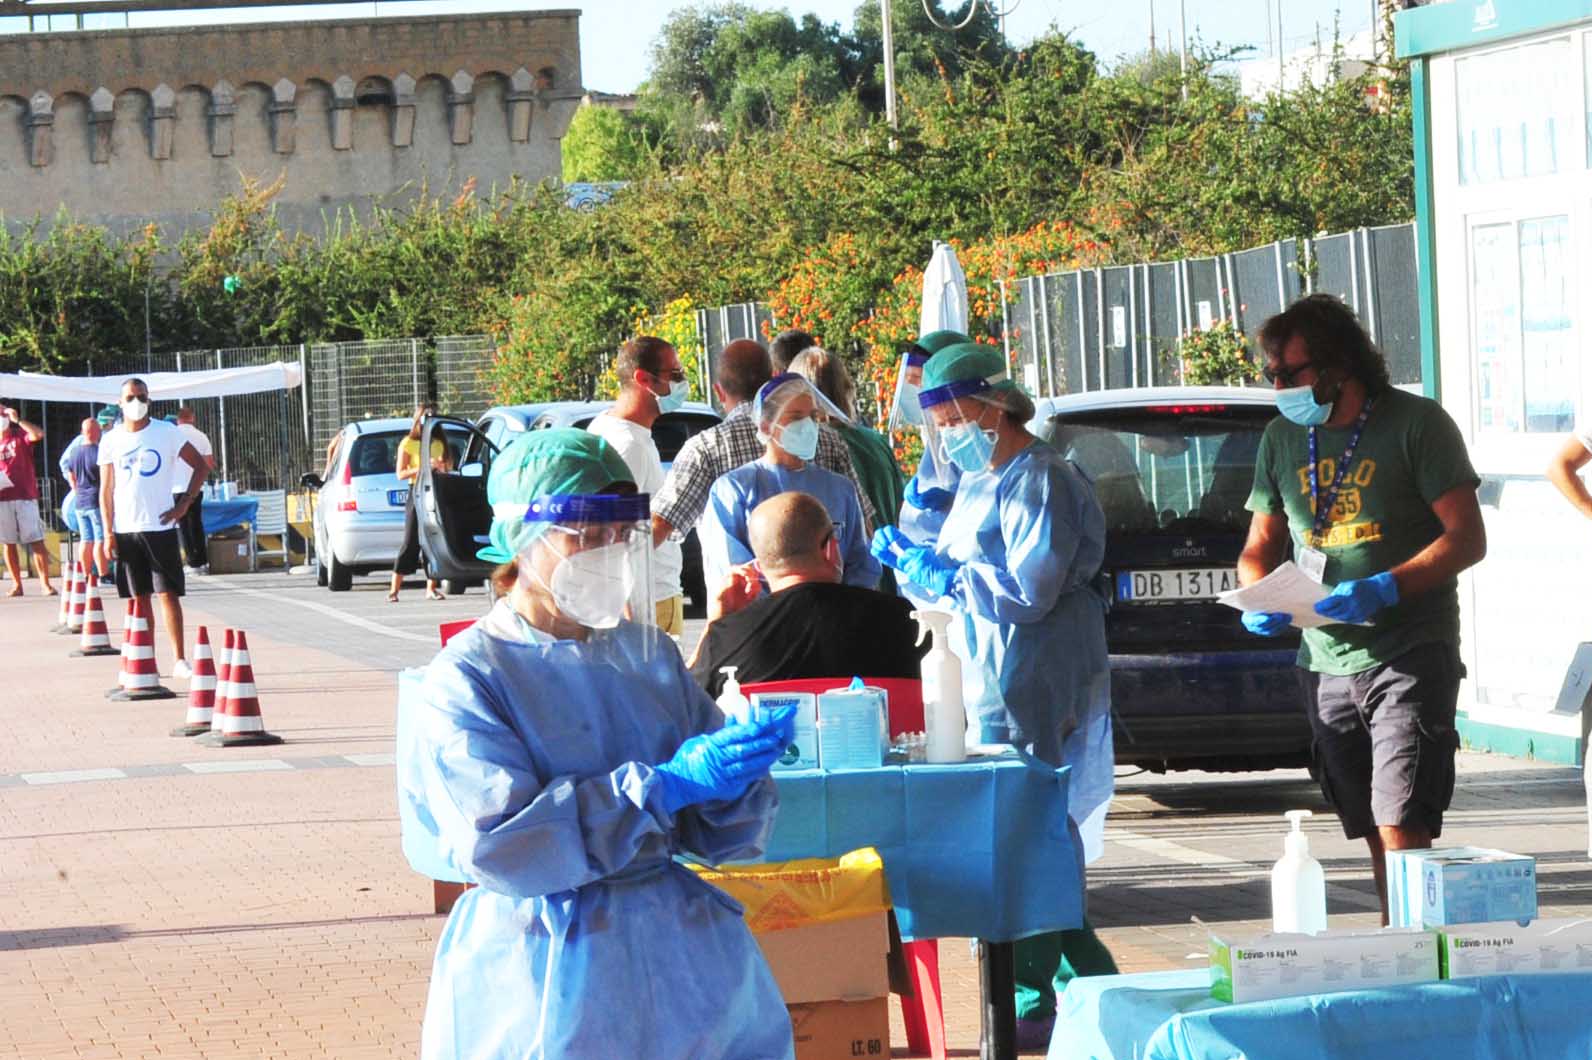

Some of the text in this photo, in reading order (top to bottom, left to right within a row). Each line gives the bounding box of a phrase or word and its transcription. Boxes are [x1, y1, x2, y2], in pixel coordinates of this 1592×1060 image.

[1172, 546, 1207, 557] smart
[1134, 573, 1163, 597] DB
[1176, 571, 1239, 596] 131A
